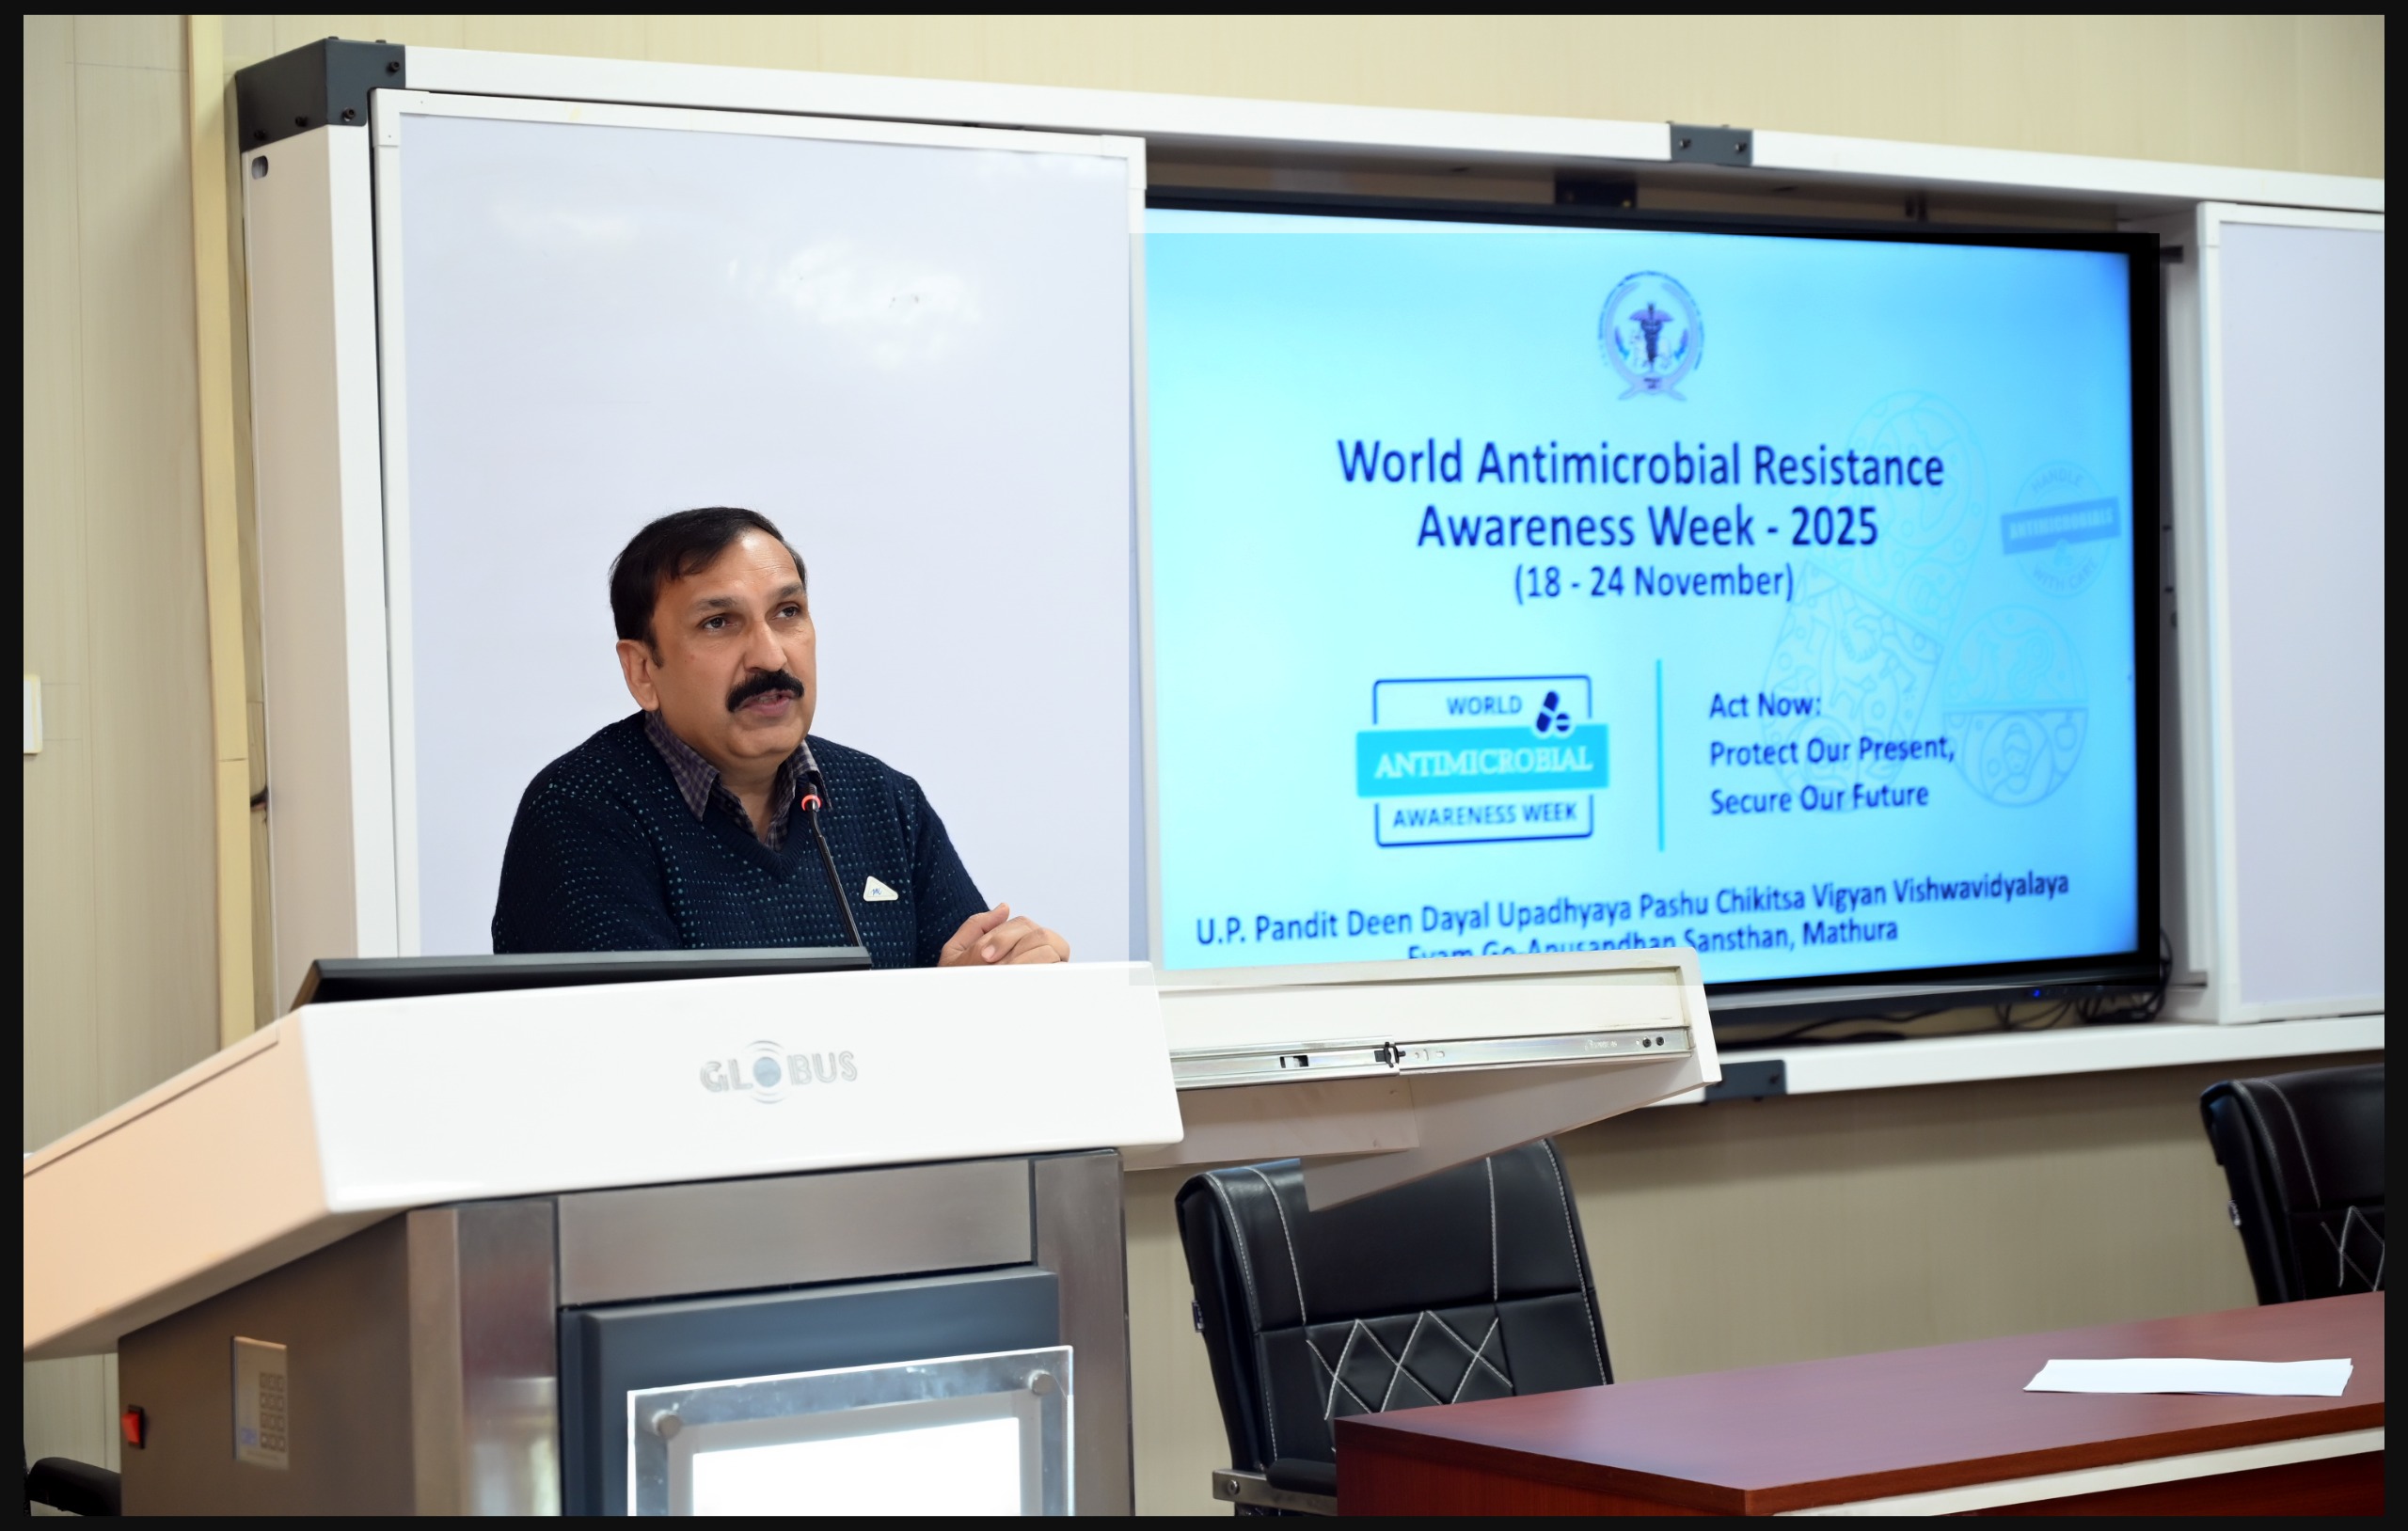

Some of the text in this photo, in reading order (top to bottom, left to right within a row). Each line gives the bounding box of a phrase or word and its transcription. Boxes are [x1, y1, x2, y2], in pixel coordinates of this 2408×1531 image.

[1338, 437, 1944, 487] World Antimicrobial Resistance
[2030, 466, 2085, 494] HANDLE
[1418, 503, 1878, 547] Awareness Week - 2025
[1514, 563, 1561, 605] (18
[1590, 565, 1625, 597] 24
[1634, 562, 1794, 603] November)
[1446, 694, 1524, 717] WORLD
[1708, 691, 1821, 719] Act Now:
[1373, 745, 1593, 780] ANTIMICROBIAL
[1710, 735, 1955, 766] Protect Our Present,
[1392, 802, 1577, 829] AWARENESS WEEK
[1710, 782, 1929, 816] Secure Our Future
[1196, 870, 2069, 945] U.P. Pandit Deen Dayal Upadhyaya Pashu Chikitsa Vigyan Vishwavidyalaya
[1684, 921, 1795, 954] Sansthan,
[1802, 917, 1899, 947] Mathura
